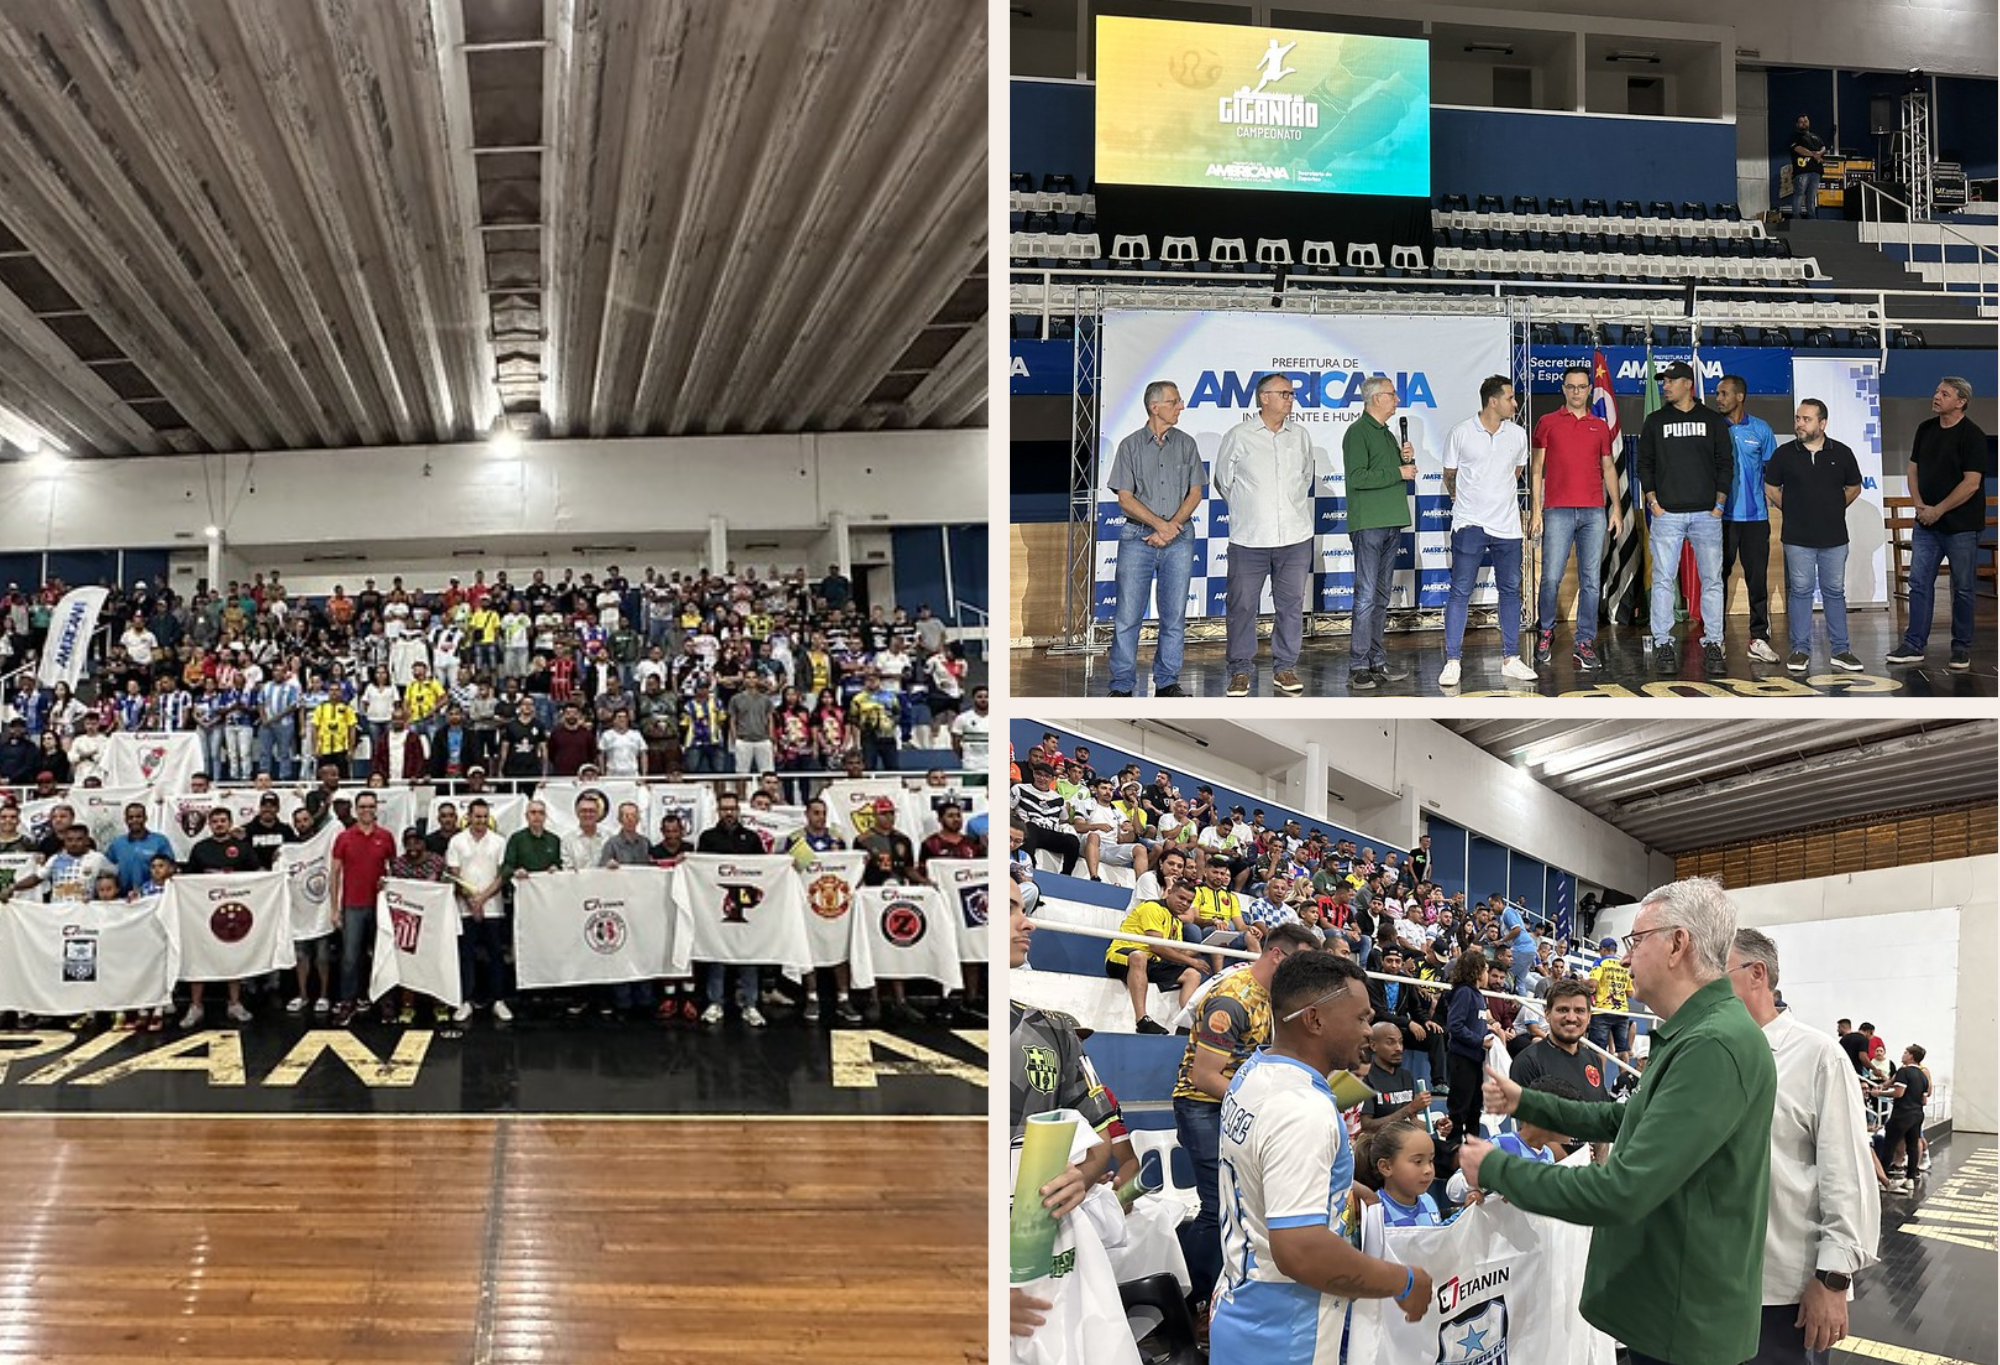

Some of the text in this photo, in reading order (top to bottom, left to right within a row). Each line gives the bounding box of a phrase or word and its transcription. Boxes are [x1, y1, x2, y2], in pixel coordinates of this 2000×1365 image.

[1236, 126, 1302, 141] CAMPEONATO
[1205, 163, 1290, 180] AMERICANA
[1272, 358, 1359, 369] PREFEITURA DE
[1530, 357, 1592, 369] Secretaria
[1186, 370, 1437, 410] AMRICANA
[1663, 421, 1707, 439] PUMA
[891, 914, 915, 936] Z
[830, 1029, 989, 1087] A
